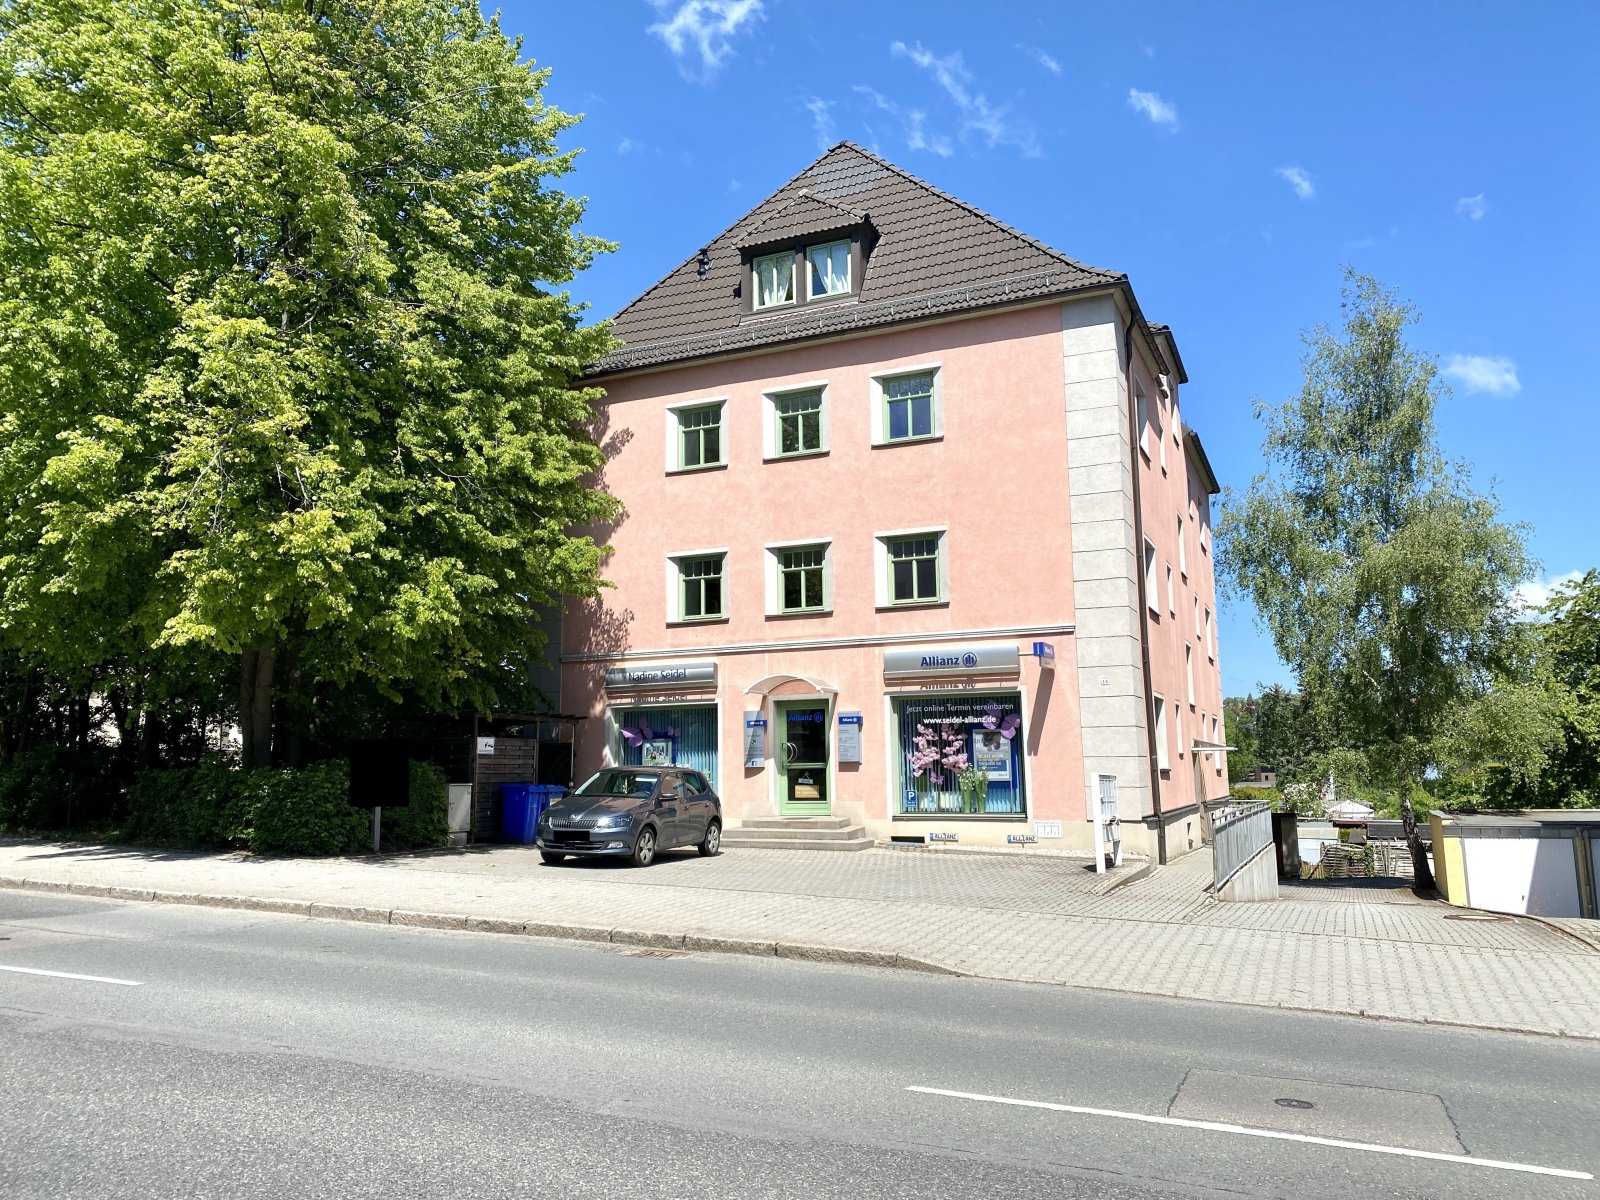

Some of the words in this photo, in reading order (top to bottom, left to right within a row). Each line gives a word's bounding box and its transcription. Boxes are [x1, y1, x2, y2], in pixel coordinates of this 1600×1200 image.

[920, 656, 960, 667] Allianz
[628, 671, 658, 681] Nadine
[660, 668, 687, 679] Seidel
[907, 705, 922, 714] Jetzt
[924, 704, 944, 712] online
[973, 702, 1014, 711] vereinbaren
[789, 713, 813, 721] Allianz
[923, 715, 996, 724] www.seidel-allianz.de
[908, 791, 915, 800] P
